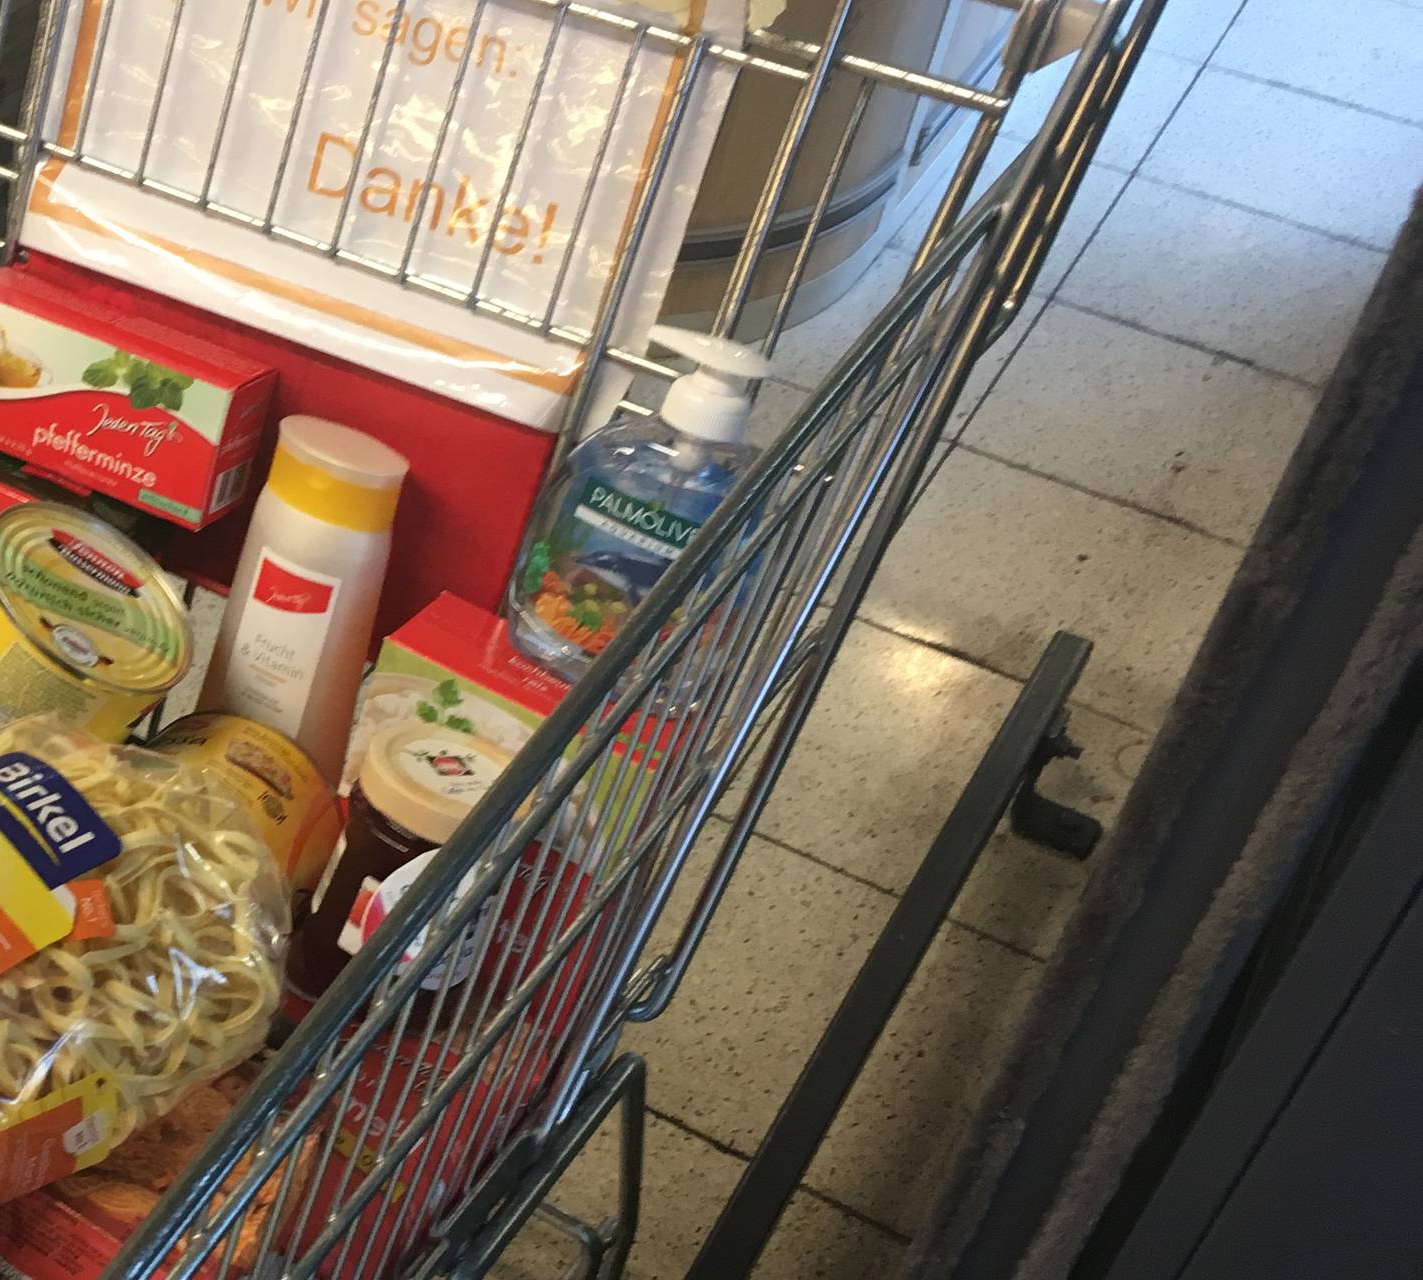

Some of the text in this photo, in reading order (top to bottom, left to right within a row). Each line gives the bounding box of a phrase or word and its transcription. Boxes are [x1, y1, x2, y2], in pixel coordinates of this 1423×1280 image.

[352, 0, 524, 77] sagen:
[307, 130, 559, 265] Danke!
[31, 422, 158, 488] pfefferminze
